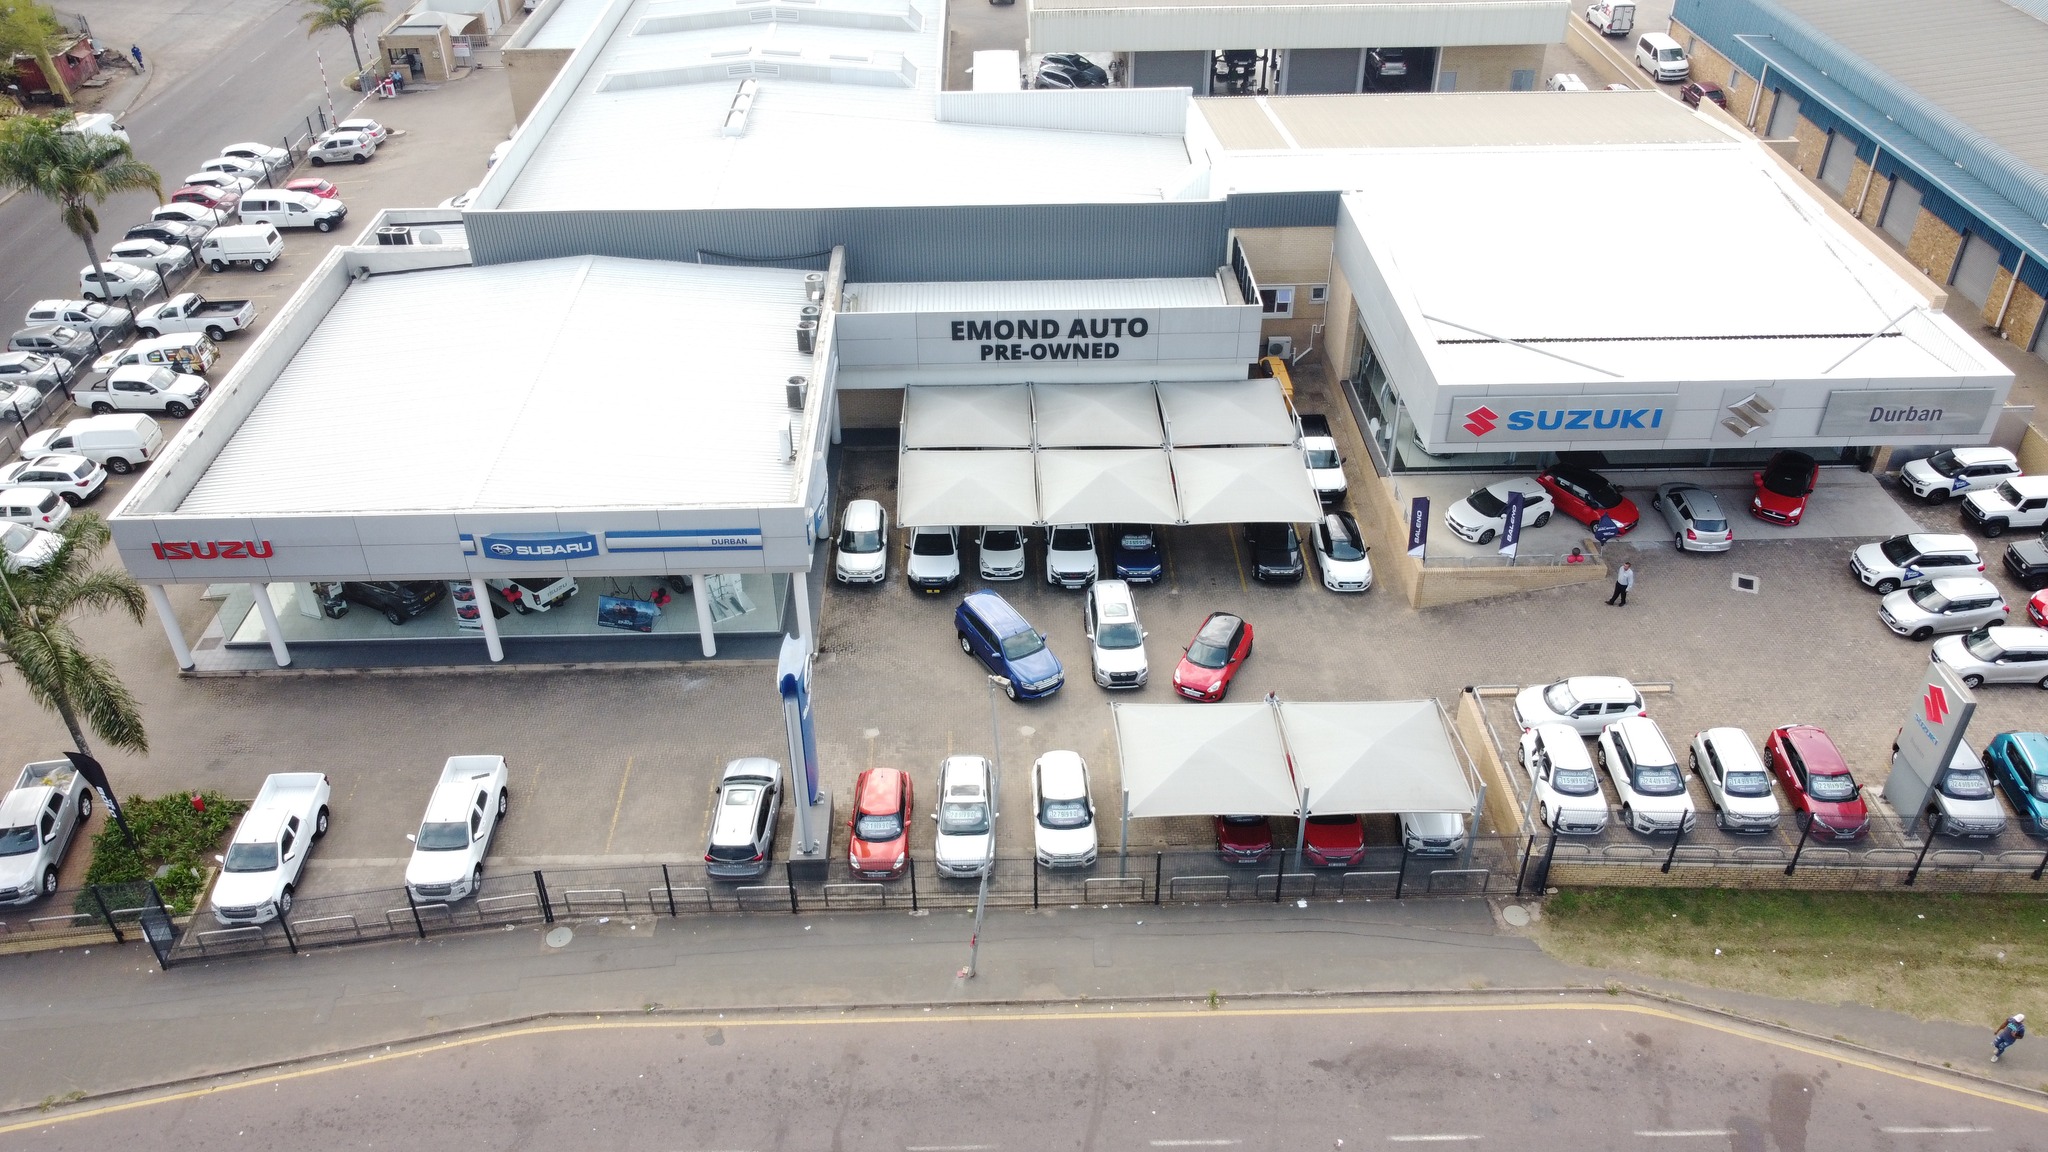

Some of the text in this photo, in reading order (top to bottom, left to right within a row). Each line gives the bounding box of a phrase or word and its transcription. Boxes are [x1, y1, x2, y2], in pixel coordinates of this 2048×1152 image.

[951, 318, 1149, 341] EMOND AUTO
[980, 342, 1120, 361] PRE-OWNED
[1507, 407, 1664, 431] SUZUKI
[1869, 405, 1944, 424] Durban
[1413, 510, 1424, 544] BALENO
[1507, 504, 1518, 543] BALENO
[152, 540, 274, 560] ISUZU
[515, 541, 593, 557] SUBARU
[711, 536, 749, 547] DURBAN
[1914, 713, 1939, 746] SUZUKI
